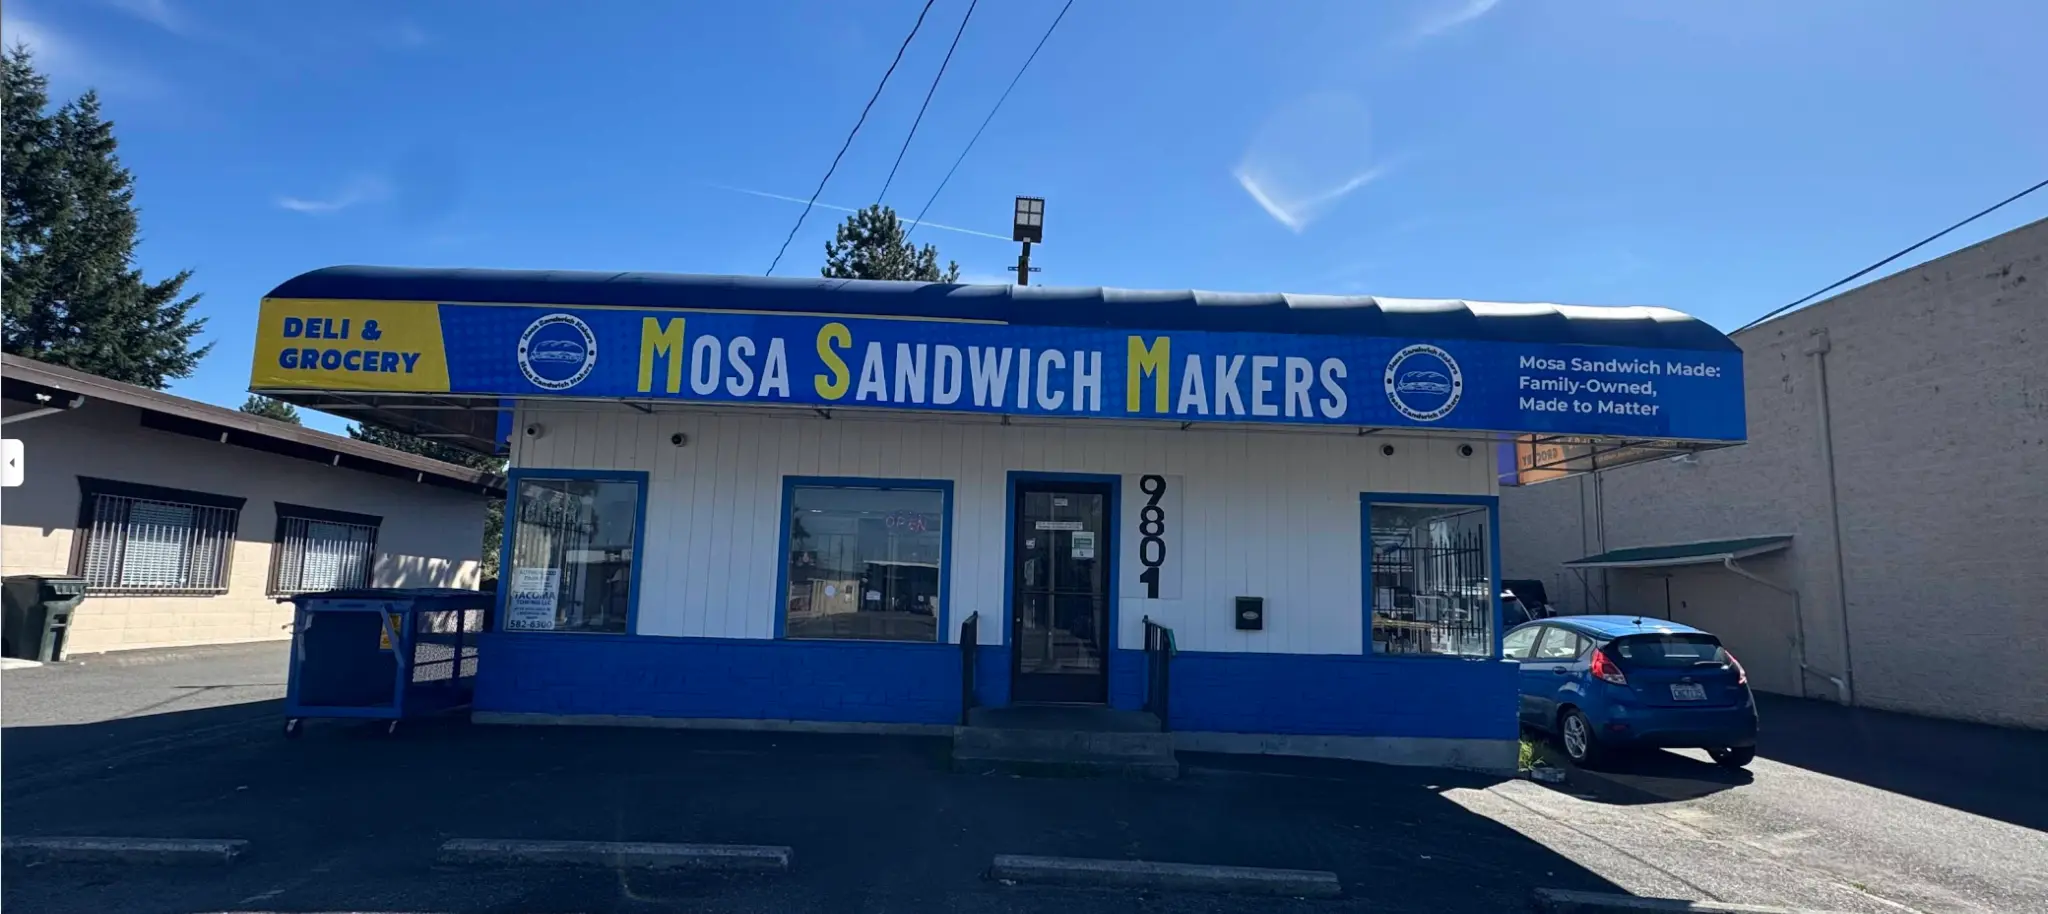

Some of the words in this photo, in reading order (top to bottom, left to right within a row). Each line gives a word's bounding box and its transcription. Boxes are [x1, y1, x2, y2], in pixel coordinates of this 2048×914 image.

[283, 317, 350, 340] DELI
[361, 319, 383, 341] &
[278, 347, 421, 374] GROCERY
[637, 317, 790, 397] MOSA
[814, 322, 1101, 412] SANDWICH
[1127, 335, 1348, 418] MAKERS
[1519, 355, 1566, 371] Mosa
[1571, 358, 1660, 375] Sandwich
[1666, 361, 1721, 378] Made:
[1519, 376, 1657, 397] Family-Owned,
[1519, 397, 1568, 412] Made
[1573, 400, 1592, 413] to
[1598, 400, 1659, 416] Matter
[885, 515, 927, 531] OPEN
[1139, 474, 1167, 599] 9801
